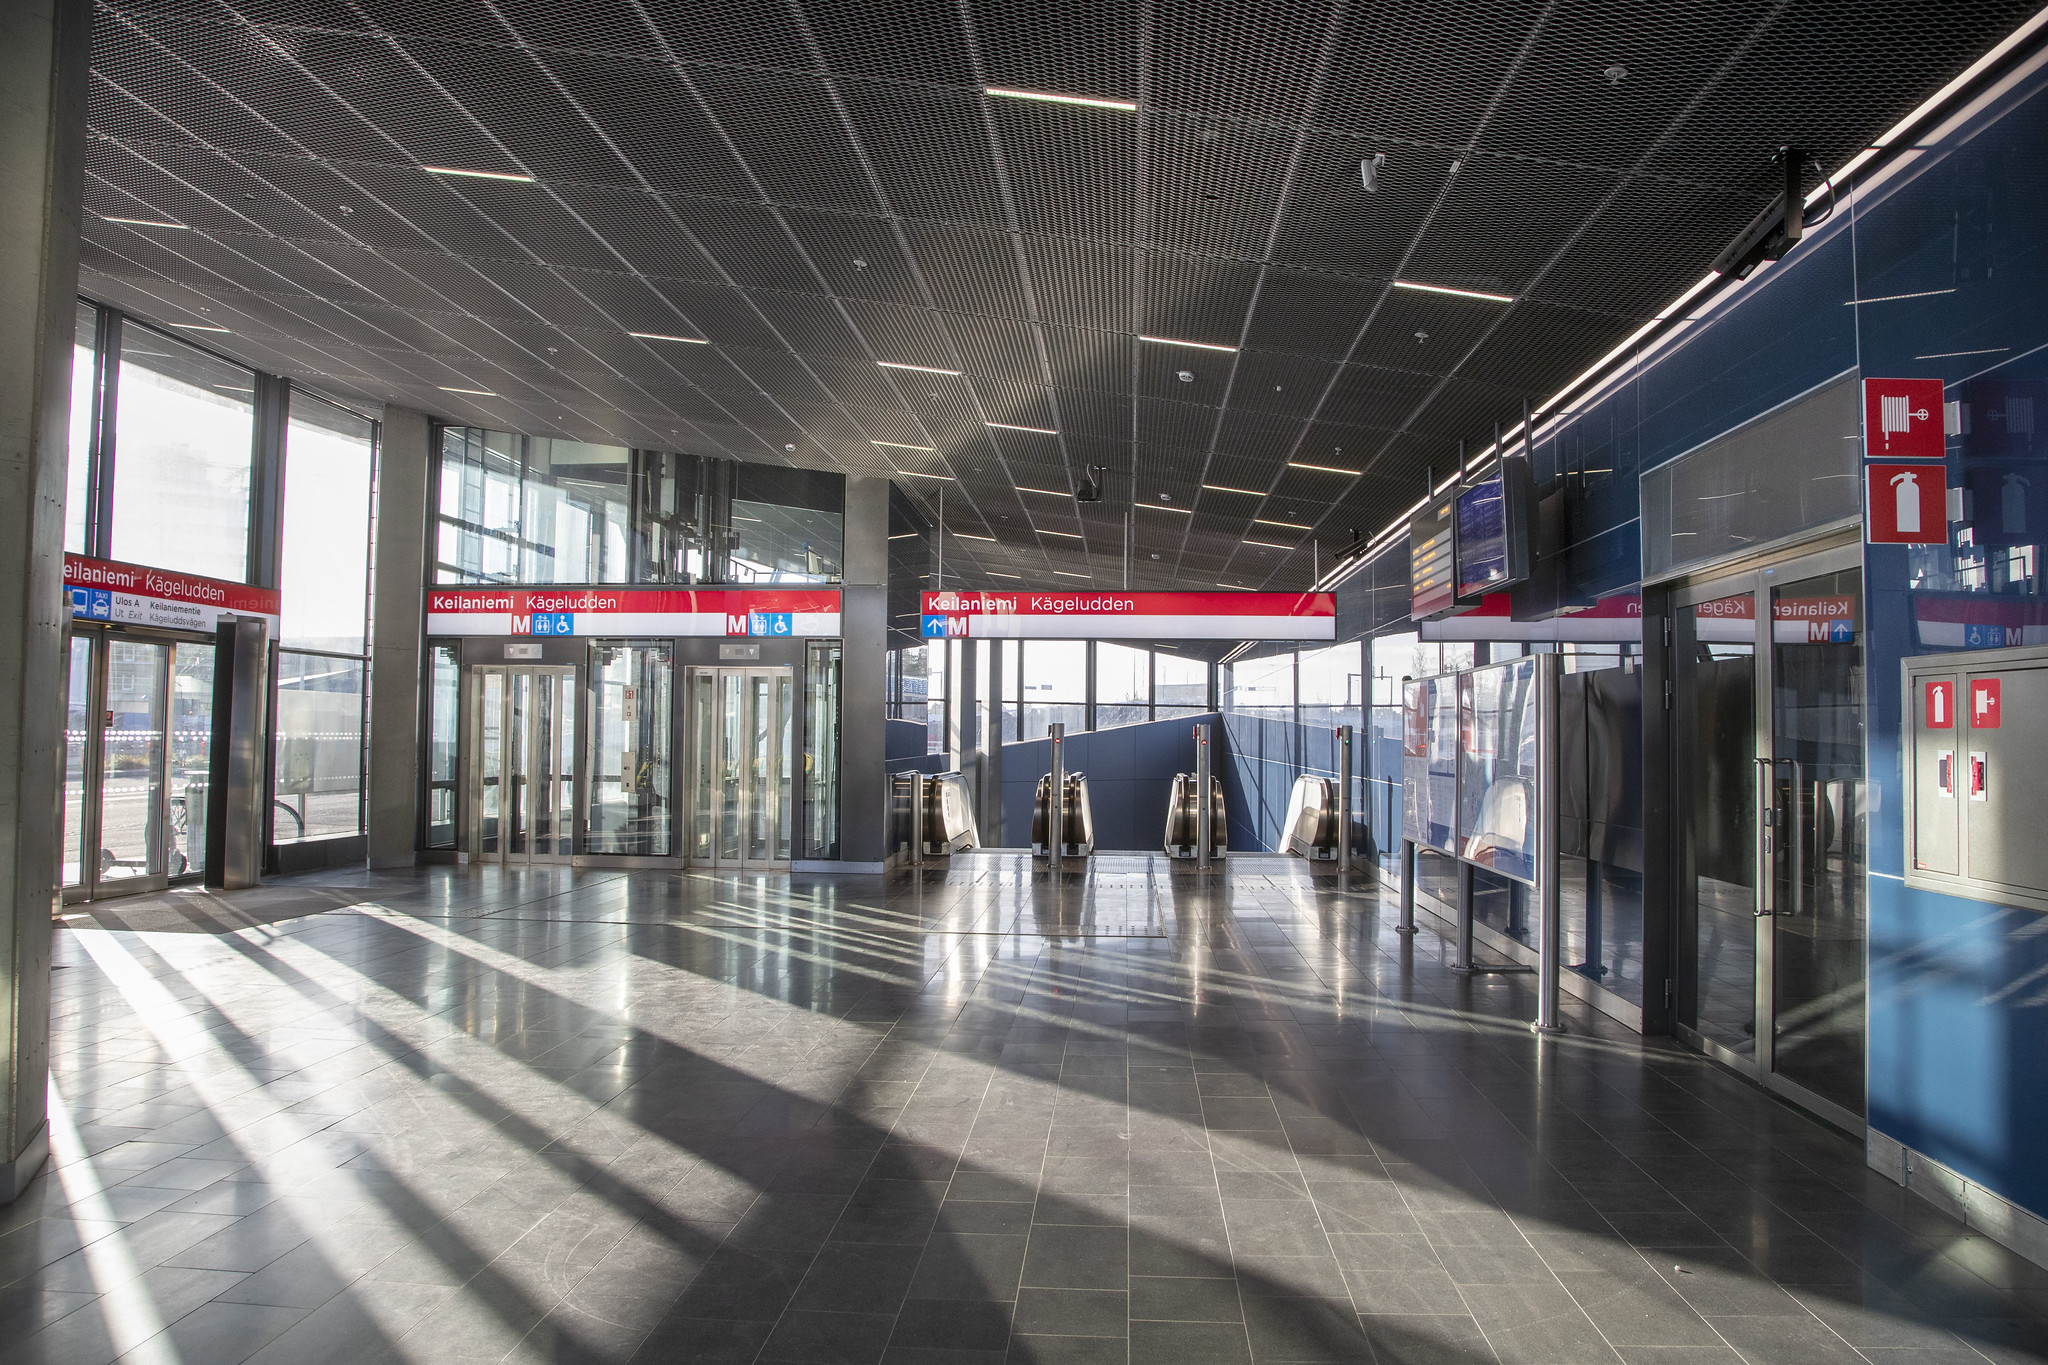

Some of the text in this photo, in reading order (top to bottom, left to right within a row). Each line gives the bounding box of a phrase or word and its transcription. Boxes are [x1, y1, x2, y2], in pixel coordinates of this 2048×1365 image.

[64, 561, 225, 601] eilaniemi Kägeludden
[95, 591, 109, 600] TAXI
[115, 597, 140, 608] Ulos A
[434, 595, 616, 611] Keilaniemi Kägeludden
[150, 601, 201, 615] Keilaniementie
[928, 596, 1134, 613] Keilaniemi Kägeludden
[115, 608, 142, 620] Ut Exit
[149, 612, 206, 628] Kägeluddsvägen
[512, 615, 530, 633] M
[728, 615, 747, 633] M
[948, 617, 967, 635] M
